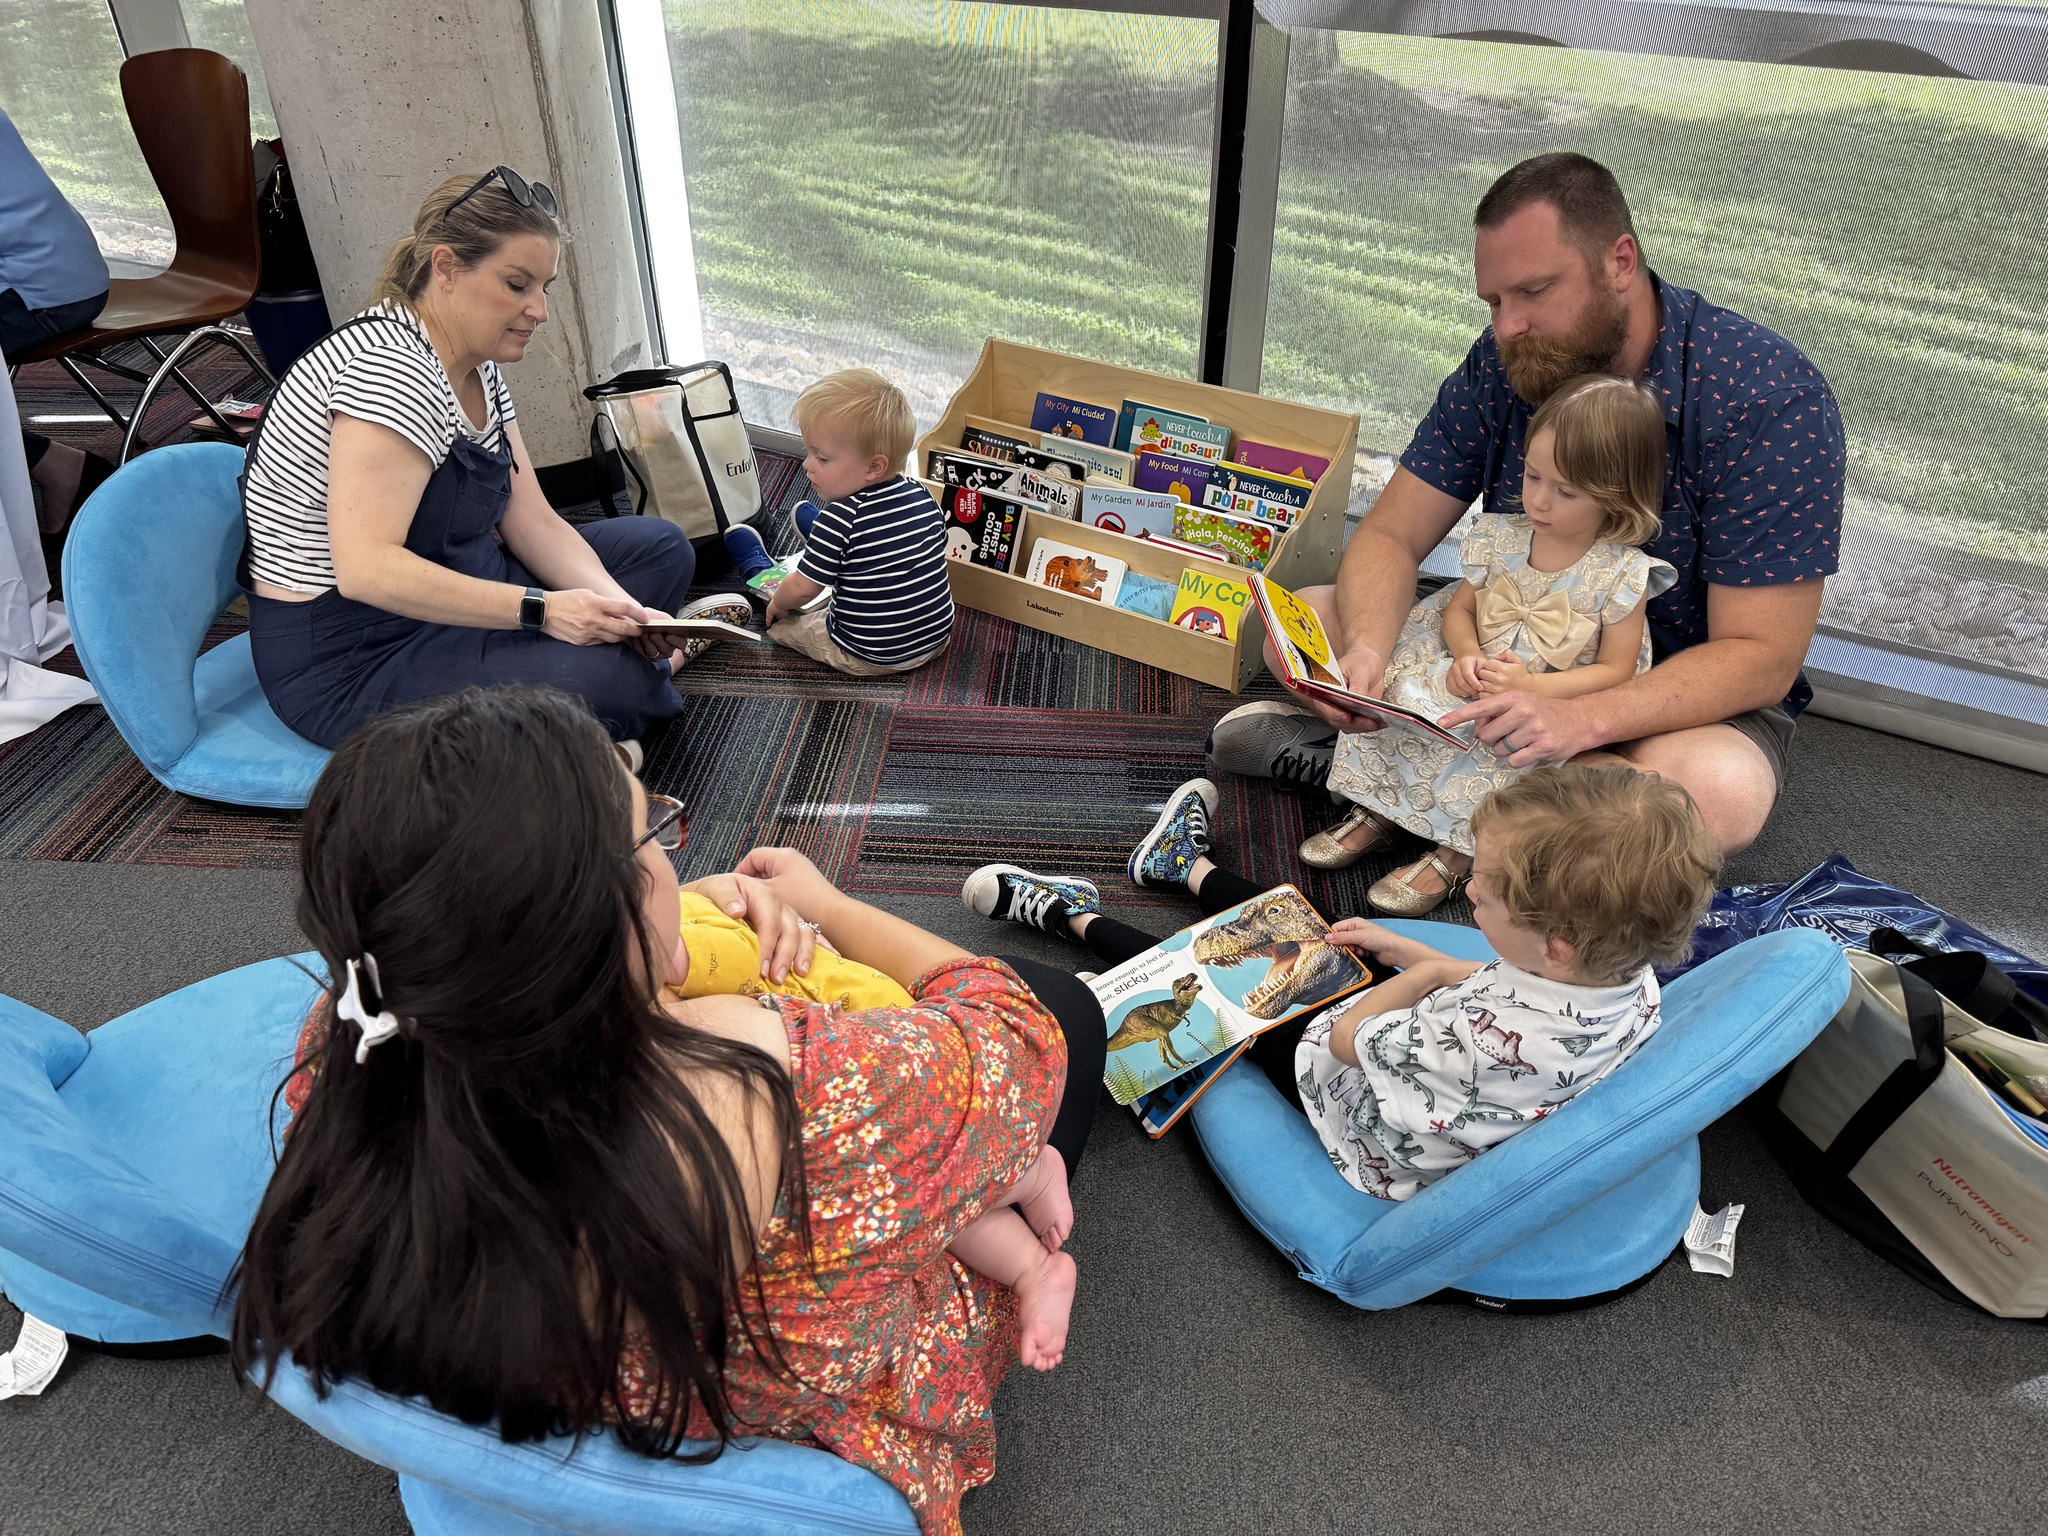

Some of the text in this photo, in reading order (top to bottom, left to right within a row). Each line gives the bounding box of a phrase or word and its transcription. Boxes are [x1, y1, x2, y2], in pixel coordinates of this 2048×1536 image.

[1045, 400, 1105, 420] My City Mi Ciudad
[1125, 407, 1135, 416] My
[1166, 422, 1185, 433] NEVER
[1186, 425, 1217, 442] touch
[1161, 437, 1222, 460] dinosaur!
[1240, 452, 1248, 466] opa
[726, 458, 752, 477] Enfa
[1104, 465, 1123, 480] azul
[1148, 460, 1209, 479] My Food Mi Com
[966, 469, 987, 491] CK
[1021, 473, 1068, 505] Animals
[1091, 494, 1171, 509] My Garden Mi Jardín
[1240, 481, 1260, 495] NEVER
[1261, 485, 1295, 505] touch
[1211, 490, 1302, 525] polar bear!
[980, 512, 996, 559] COLORS
[990, 521, 1002, 556] FIRST
[995, 505, 1015, 570] BABY SEE
[1216, 530, 1254, 555] perrito!
[1180, 572, 1213, 599] My
[1027, 601, 1061, 617] Lakeshore
[1095, 980, 1114, 992] brave
[1115, 967, 1139, 982] enough
[1146, 956, 1158, 965] feel
[1101, 960, 1174, 1003] soft, sticky tongue?
[1933, 1158, 2029, 1243] Nutramigen
[1918, 1172, 2013, 1257] PURAMINO
